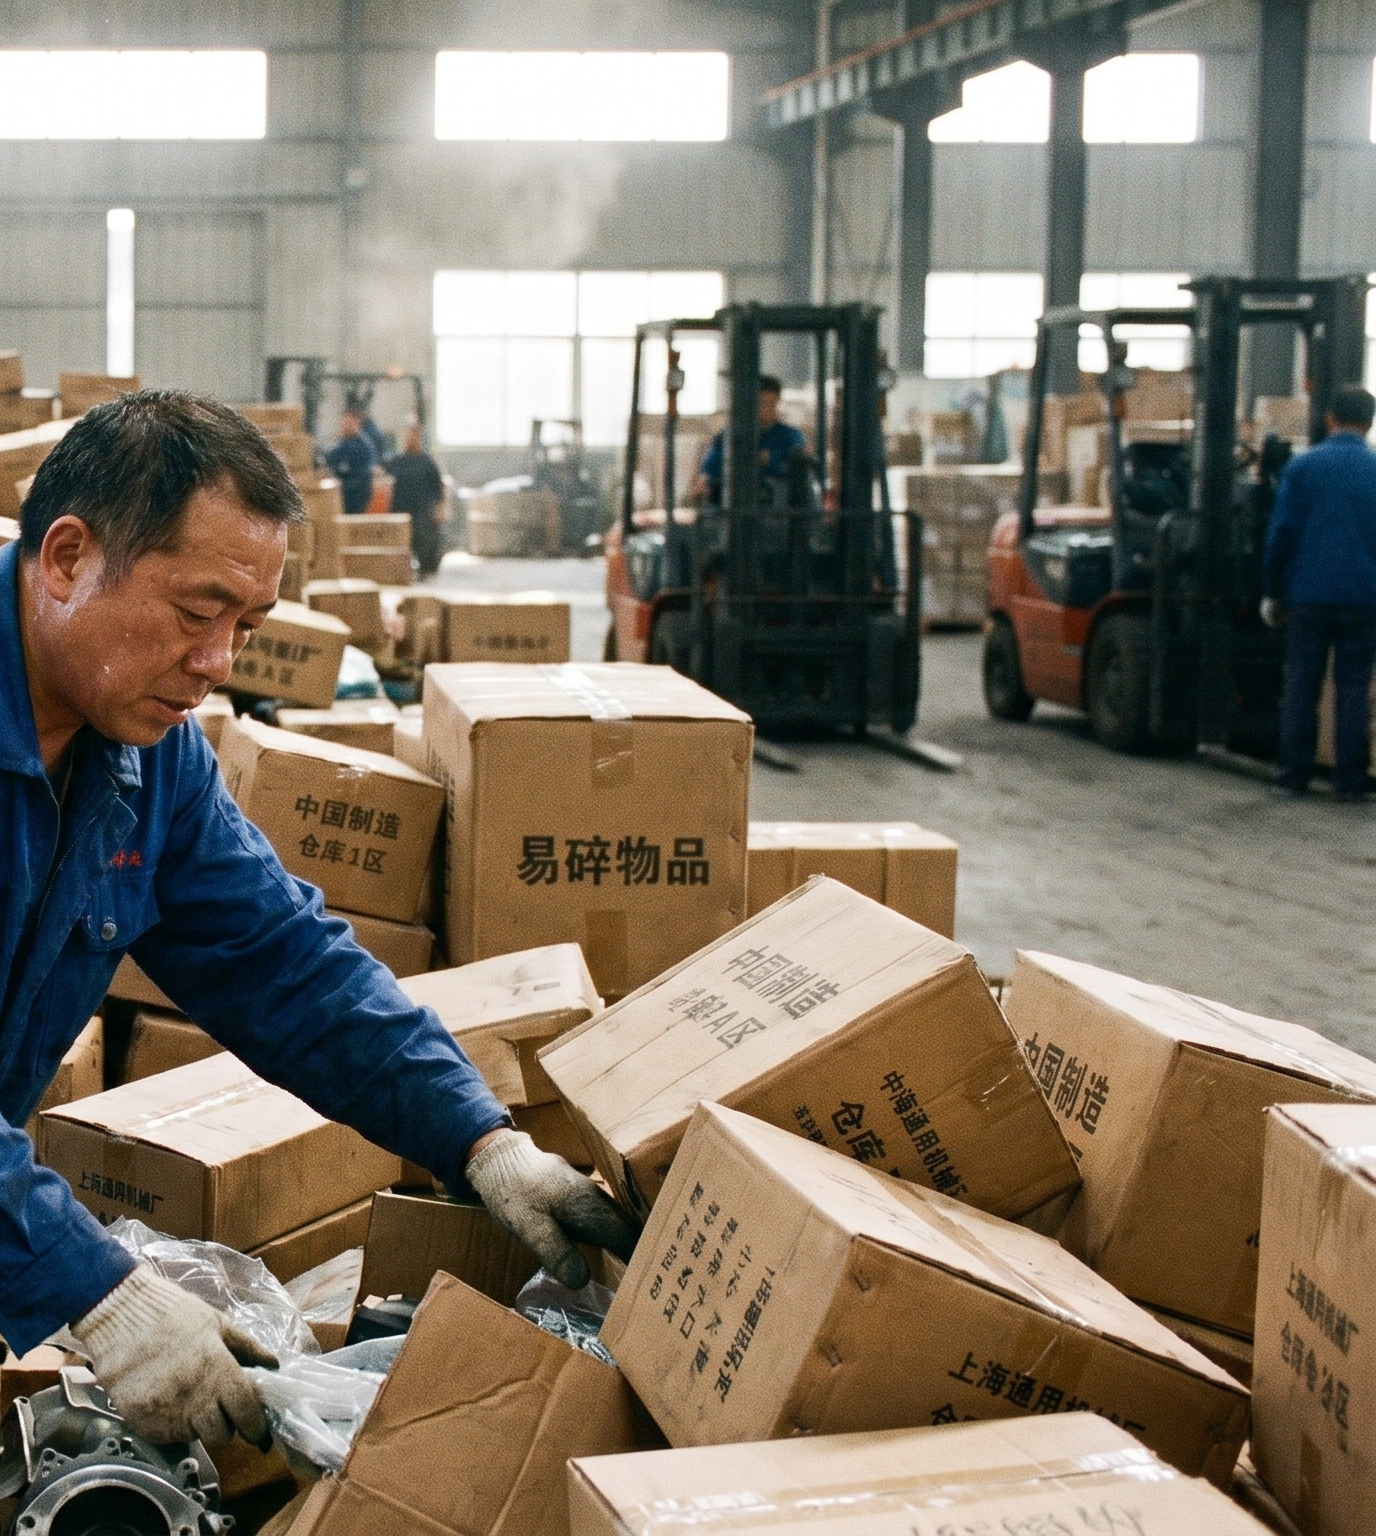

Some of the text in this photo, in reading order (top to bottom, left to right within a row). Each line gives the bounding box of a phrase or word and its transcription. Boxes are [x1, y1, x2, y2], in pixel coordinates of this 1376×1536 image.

[294, 793, 400, 840] 中国制造
[517, 835, 710, 886] 易碎物品
[831, 1101, 901, 1179] 仓库
